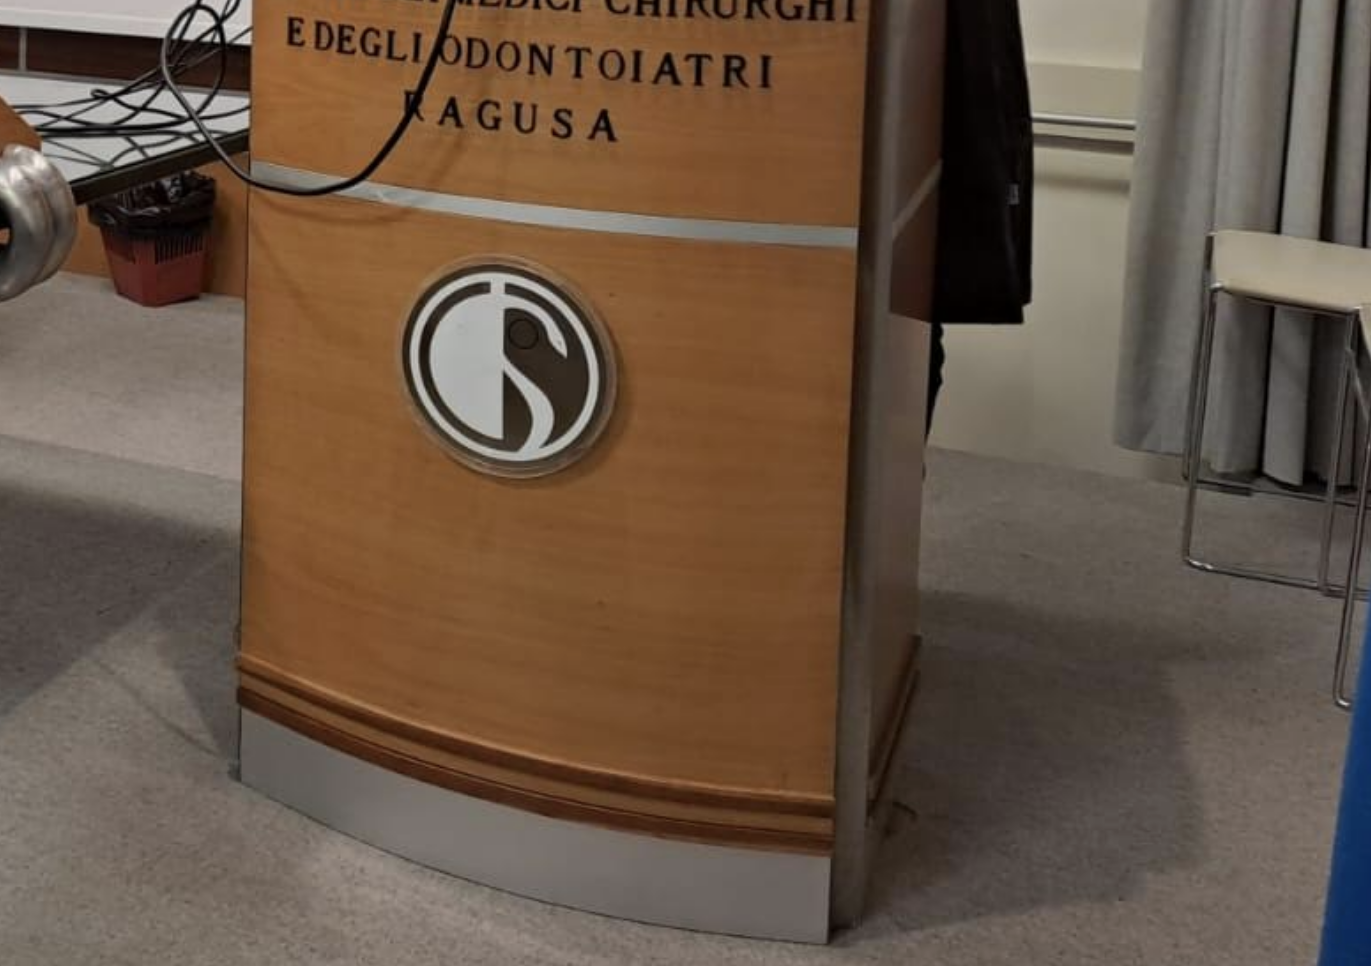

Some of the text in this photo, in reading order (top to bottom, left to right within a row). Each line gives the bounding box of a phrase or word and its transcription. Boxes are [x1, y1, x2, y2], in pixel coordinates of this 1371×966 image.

[286, 16, 773, 89] E DEGLI ODONTOIATRI
[403, 90, 618, 143] RAGUSA
